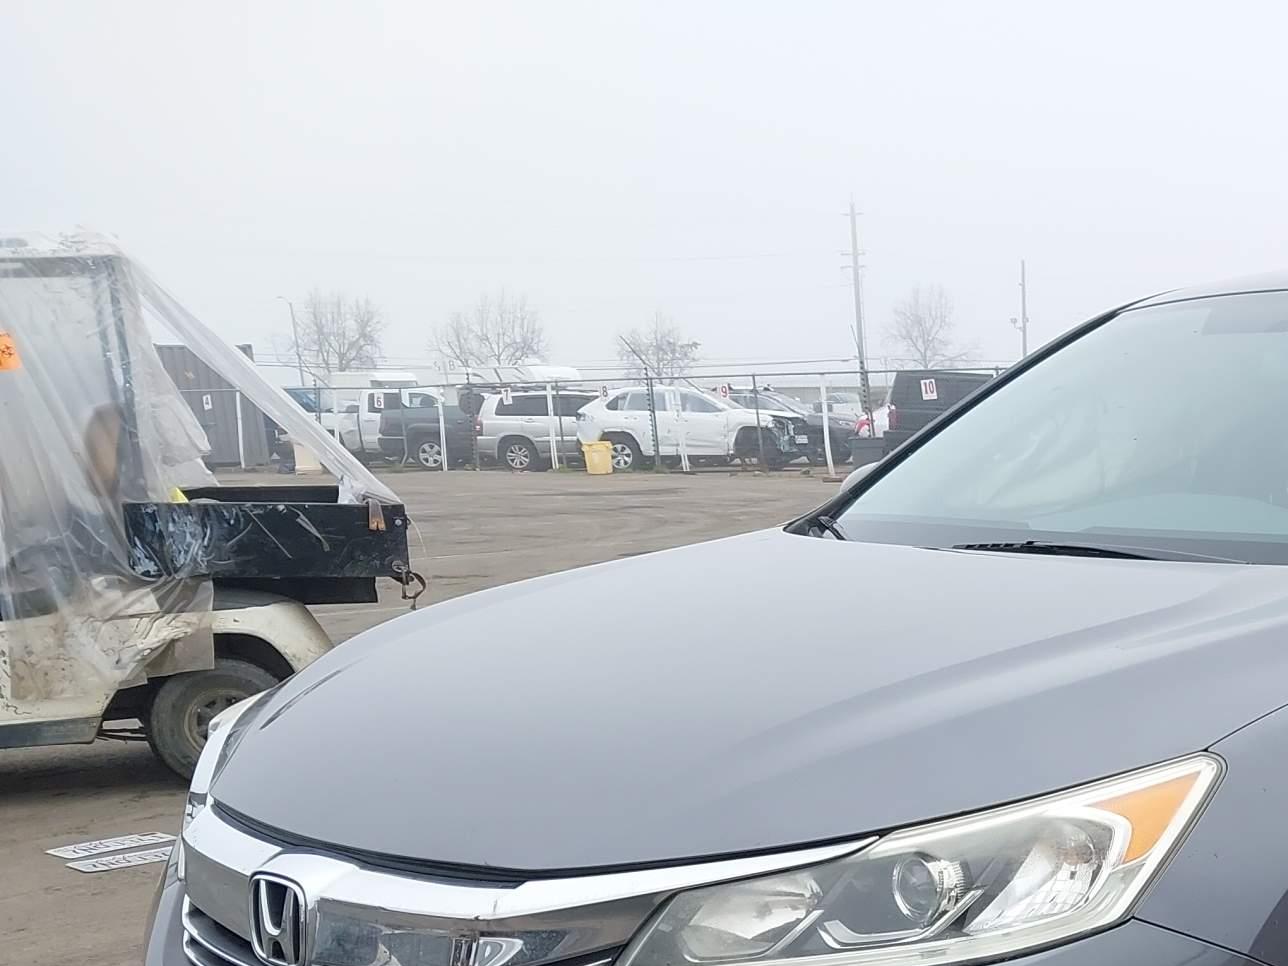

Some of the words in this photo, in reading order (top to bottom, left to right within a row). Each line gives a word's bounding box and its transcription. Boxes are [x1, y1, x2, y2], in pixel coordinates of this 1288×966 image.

[720, 386, 728, 398] 9
[922, 380, 935, 394] 10
[375, 396, 383, 408] 6
